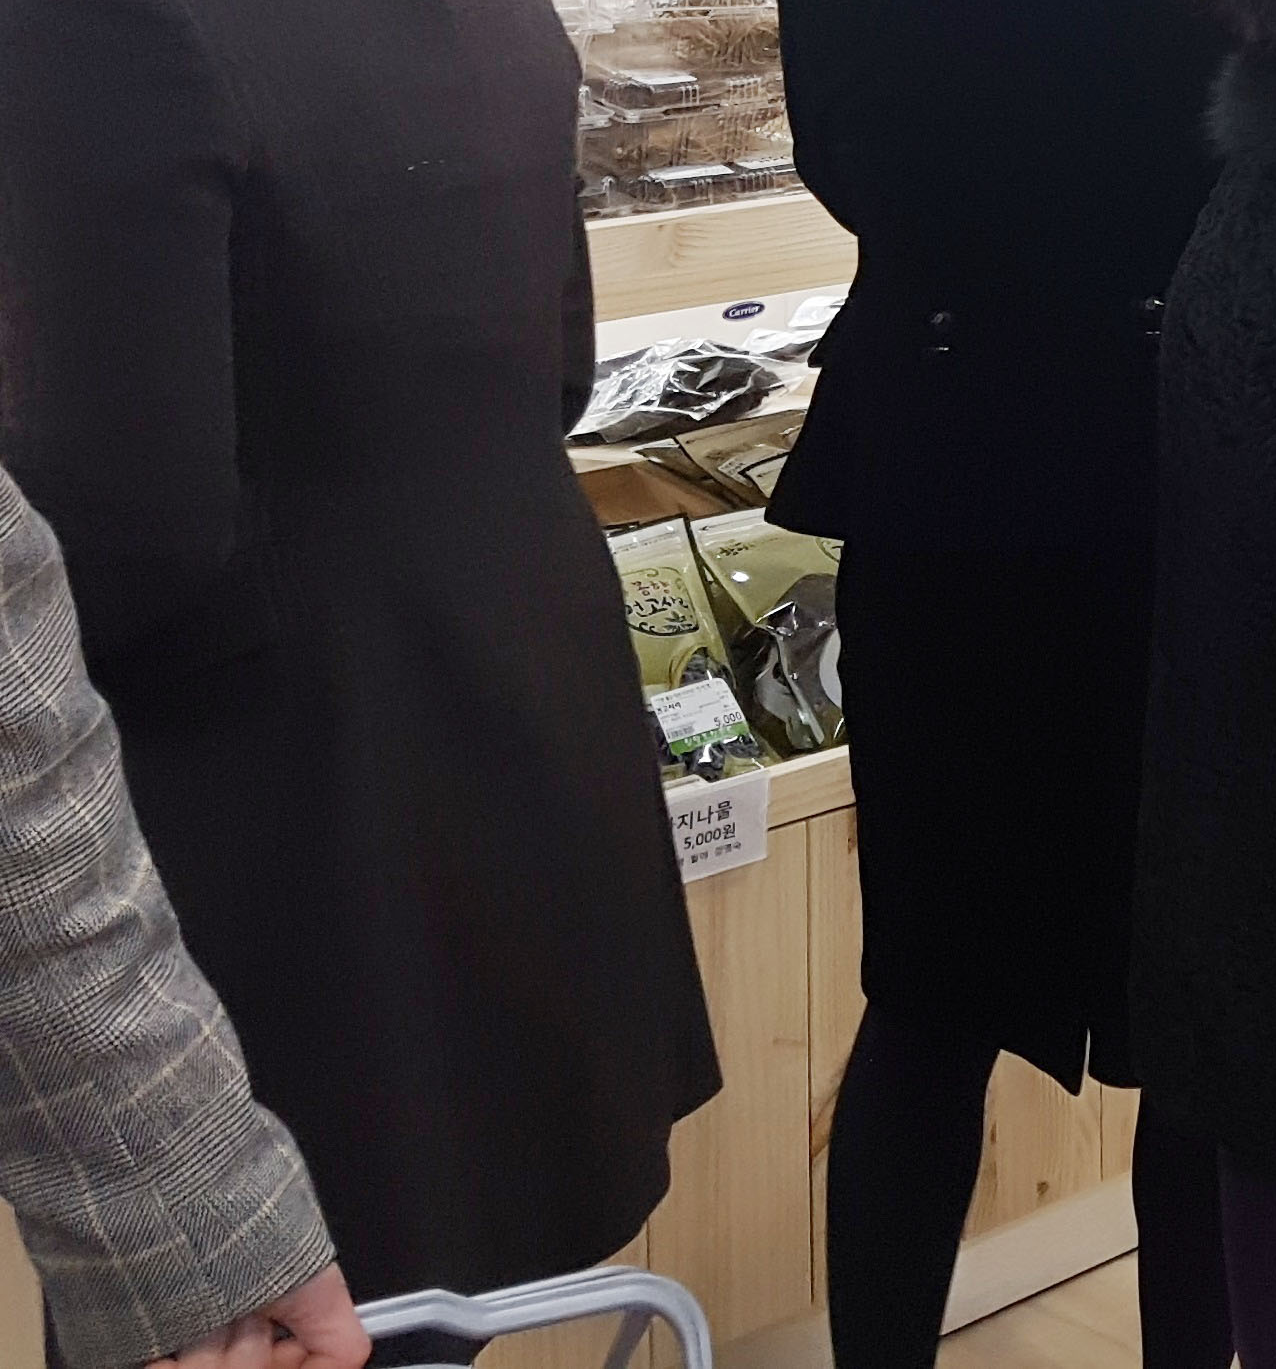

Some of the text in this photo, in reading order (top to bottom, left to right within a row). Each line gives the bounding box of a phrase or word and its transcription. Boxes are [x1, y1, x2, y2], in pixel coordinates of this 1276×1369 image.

[729, 305, 760, 318] Carrier
[713, 711, 742, 727] 5,000
[670, 800, 733, 830] 지나물
[683, 822, 736, 850] 5,000원
